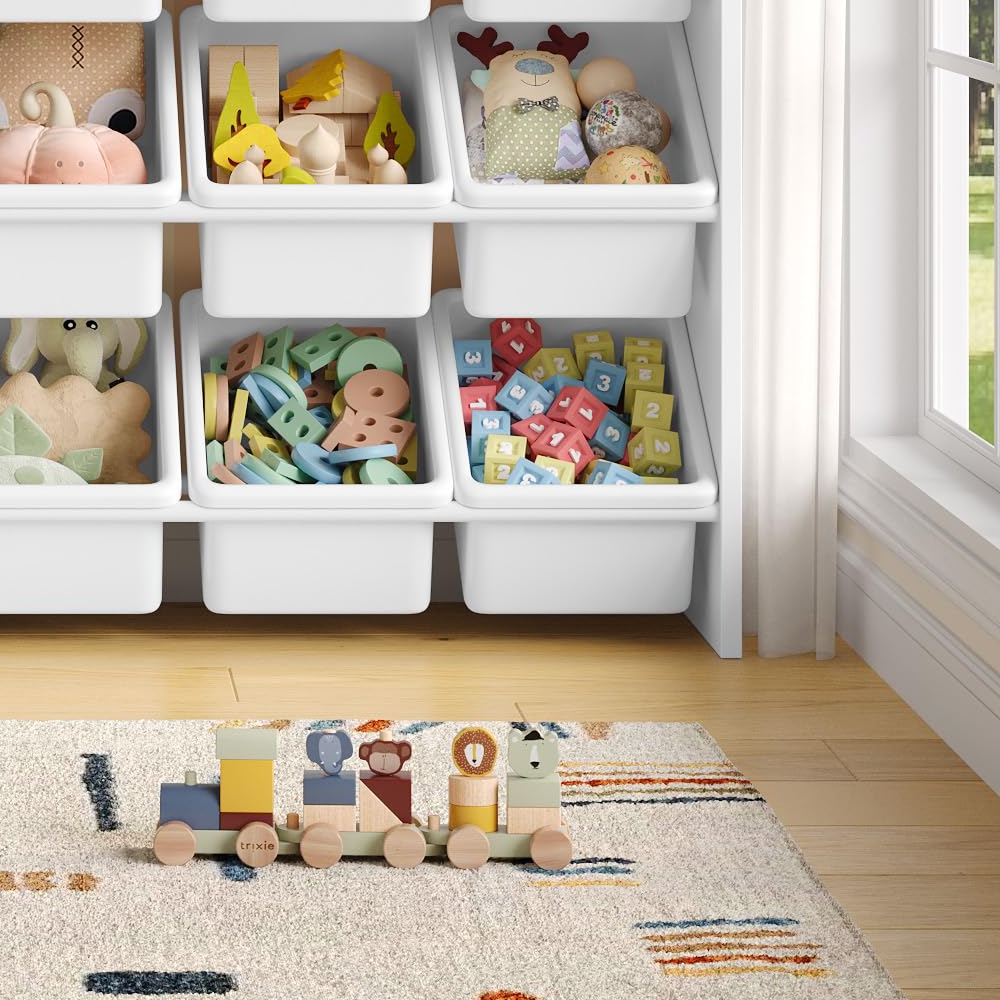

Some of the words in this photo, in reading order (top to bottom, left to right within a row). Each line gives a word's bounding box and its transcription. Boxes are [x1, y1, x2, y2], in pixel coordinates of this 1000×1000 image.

[464, 351, 482, 365] 3
[596, 375, 611, 392] 3
[646, 402, 660, 418] 2
[550, 432, 565, 447] 1
[497, 464, 511, 480] 2
[240, 840, 275, 850] trixie
